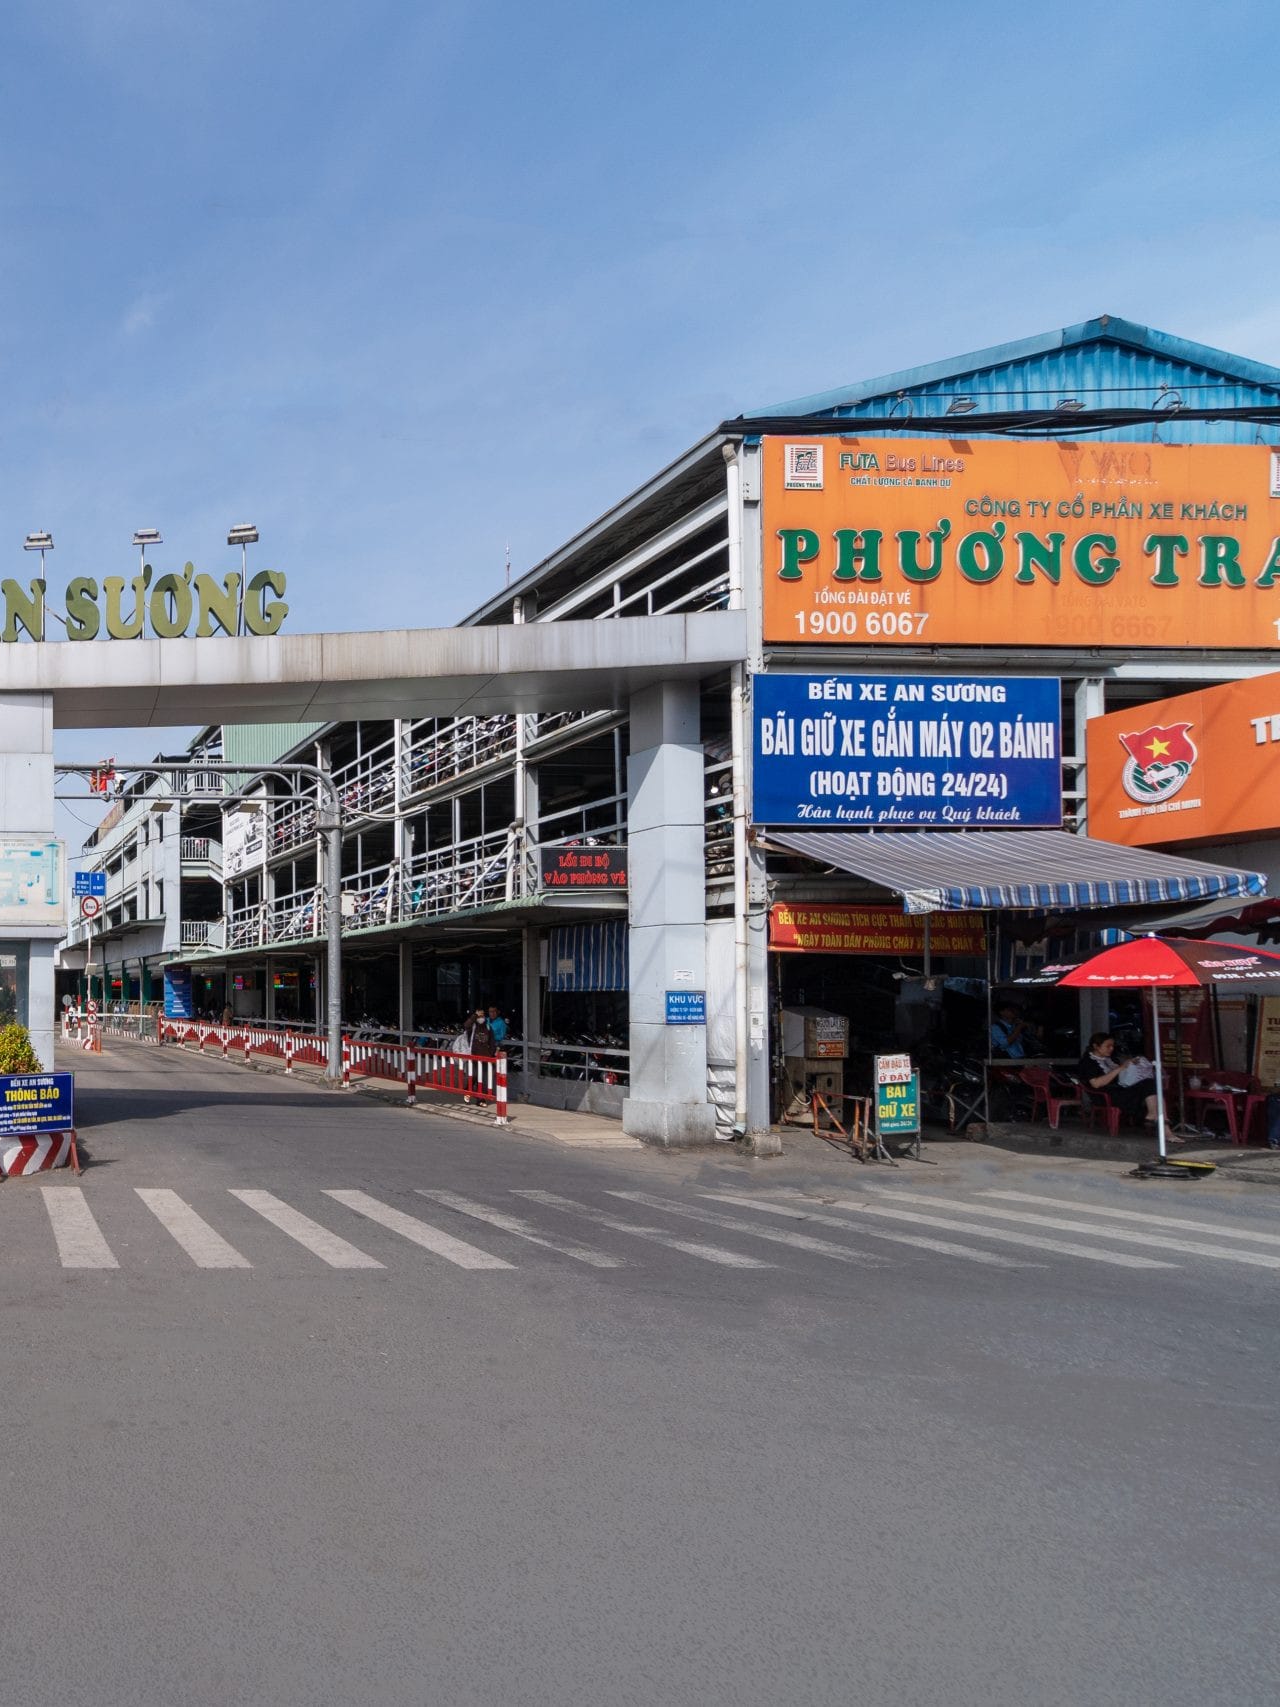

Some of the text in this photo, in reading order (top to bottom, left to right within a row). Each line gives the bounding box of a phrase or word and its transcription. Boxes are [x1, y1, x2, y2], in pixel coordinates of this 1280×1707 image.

[839, 453, 964, 472] FUTA Bus Lines
[851, 475, 871, 486] CHẤT
[965, 492, 1248, 520] CÔNG TY CỔ PHẦN XE KHÁCH
[776, 518, 1121, 586] PHƯƠNG
[66, 561, 289, 642] SƯƠNG
[814, 585, 911, 606] TỔNG ĐÀI ĐẶT VÉ
[794, 611, 929, 635] 1900 6067
[809, 677, 1006, 703] BẾN XE AN SƯƠNG
[761, 706, 1054, 759] BÃI GIỮ XE GẮN MÁY 02 BÁNH
[810, 767, 1007, 801] (HOẠT ĐỘNG 24/24)
[797, 804, 1021, 823] Hân hạnh phục vụ Quý khách
[559, 851, 577, 867] LỐI
[595, 852, 610, 869] BỘ
[544, 870, 626, 885] VÀO PHÒNG VÉ
[797, 911, 807, 925] XE
[809, 912, 822, 925] AN
[821, 931, 842, 947] TOÀN
[669, 994, 704, 1005] KHU VỰC
[21, 1079, 28, 1087] XE
[879, 1072, 887, 1082] Ở
[5, 1086, 59, 1102] THÔNG BÁO
[879, 1101, 916, 1118] GIỮ XE
